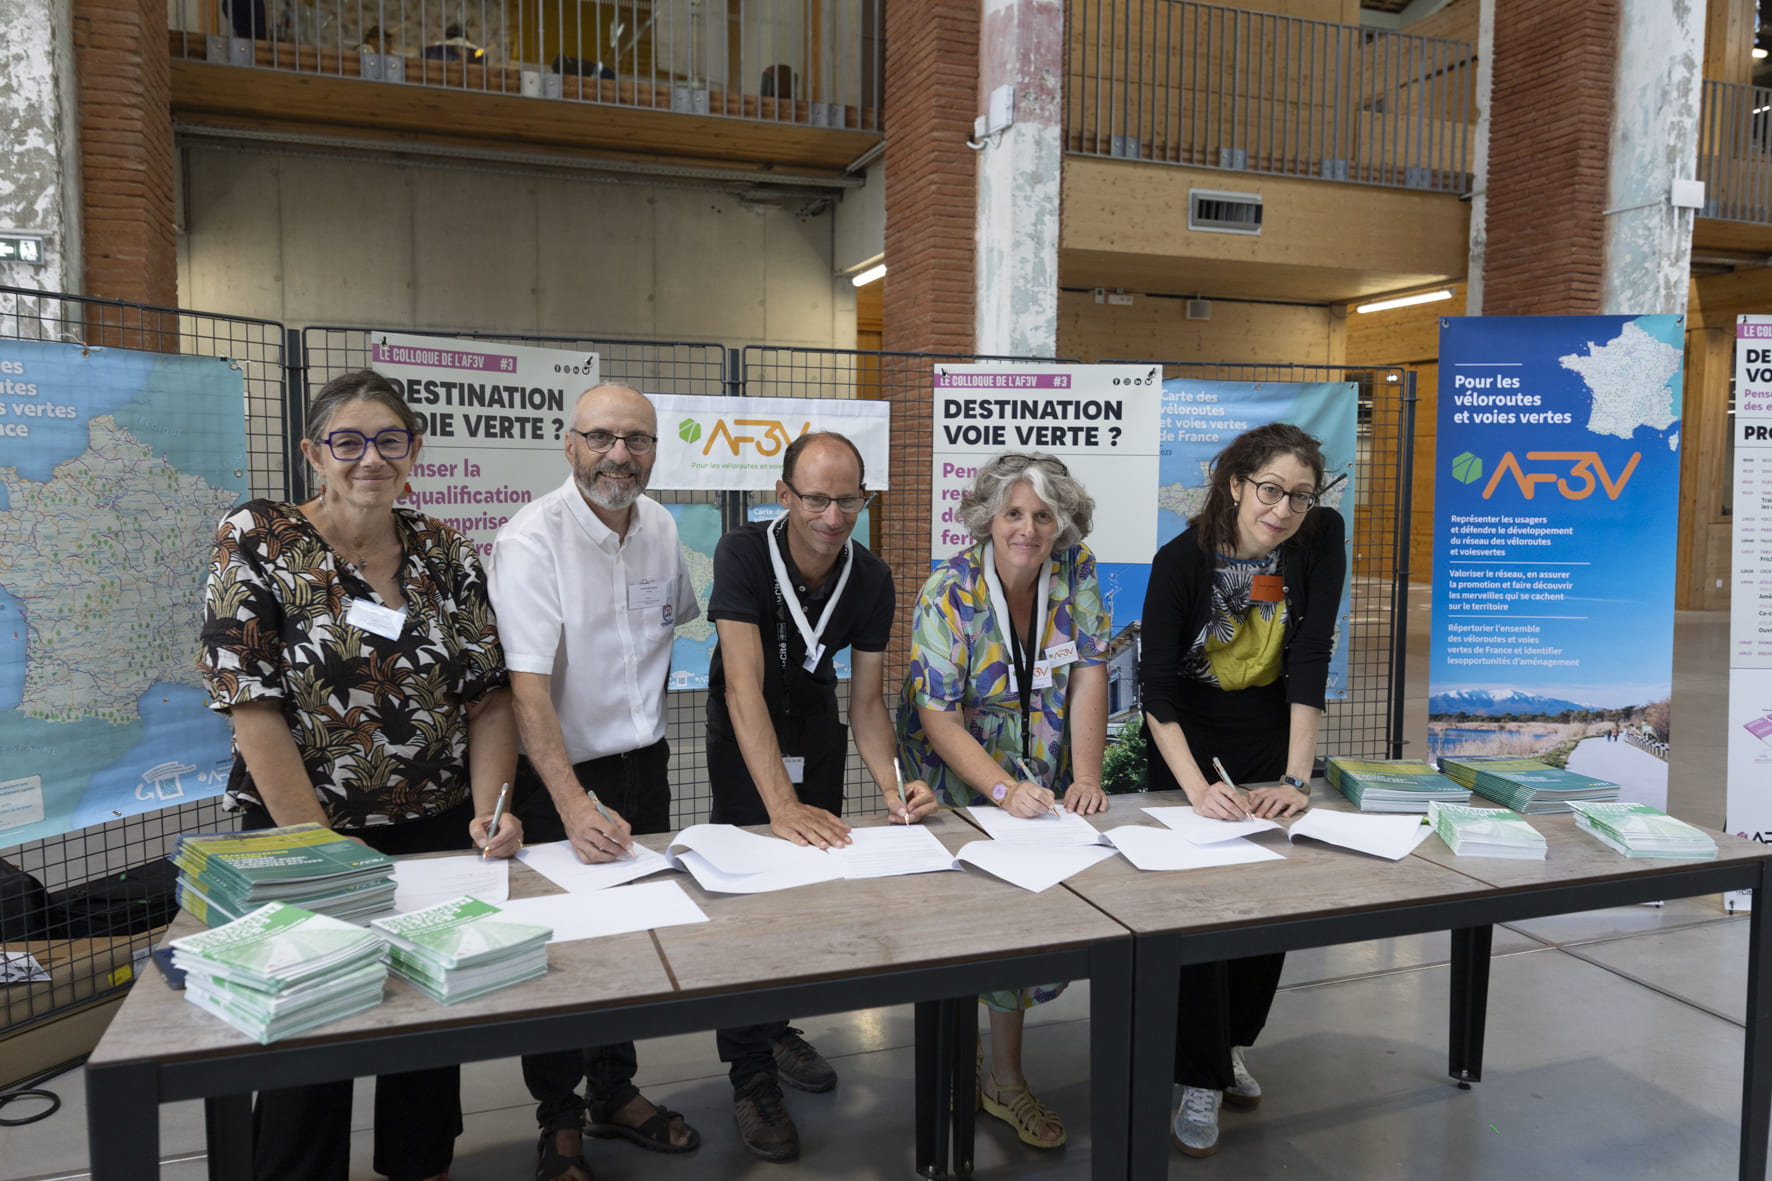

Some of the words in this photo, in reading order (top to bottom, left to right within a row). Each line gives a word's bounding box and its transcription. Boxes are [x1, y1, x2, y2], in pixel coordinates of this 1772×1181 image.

[1744, 325, 1755, 337] LE
[393, 348, 440, 365] COLLOQUE
[441, 353, 453, 366] DE
[455, 353, 485, 368] L'AF3V
[500, 358, 513, 370] #3
[952, 375, 994, 387] COLLOQUE
[996, 376, 1007, 387] DE
[1008, 376, 1038, 387] L'AF3V
[1053, 376, 1068, 388] #3
[1454, 375, 1493, 388] Pour
[1497, 374, 1520, 388] les
[1161, 389, 1194, 402] Carte
[1197, 391, 1219, 403] des
[1454, 391, 1542, 406] véloroutes
[11, 401, 78, 418] vertes
[943, 399, 1123, 421] DESTINATION
[1160, 402, 1225, 416] véloroutes
[1744, 401, 1763, 411] des
[1160, 417, 1172, 428] et
[1175, 416, 1207, 429] voies
[1209, 418, 1248, 430] vertes
[1454, 411, 1470, 424] et
[1473, 409, 1516, 424] voies
[1519, 411, 1572, 424] vertes
[463, 414, 545, 440] VERTE
[552, 418, 564, 440] ?
[943, 425, 1006, 446] VOIE
[1015, 426, 1100, 447] VERTE
[1109, 426, 1122, 447] ?
[1160, 429, 1175, 442] de
[1178, 429, 1219, 442] France
[408, 463, 458, 478] nser
[464, 458, 481, 478] la
[1482, 451, 1642, 500] AF3V
[396, 485, 532, 510] equalification
[753, 508, 774, 516] Carte
[1451, 514, 1499, 524] Représenter
[1501, 515, 1513, 524] les
[1515, 516, 1547, 525] usagers
[1450, 526, 1459, 534] et
[1460, 525, 1496, 534] défendre
[1498, 526, 1506, 534] le
[1507, 526, 1573, 536] développement
[1450, 537, 1461, 545] du
[1462, 536, 1489, 545] réseau
[1490, 537, 1505, 545] des
[1507, 537, 1551, 546] véloroutes
[1450, 548, 1459, 556] et
[1449, 569, 1485, 578] Valoriser
[1486, 570, 1494, 578] le
[1495, 569, 1526, 579] réseau,
[1539, 571, 1570, 579] assurer
[1458, 581, 1500, 590] promotion
[1502, 581, 1511, 589] et
[1512, 580, 1532, 589] faire
[1533, 581, 1573, 590] découvrir
[1449, 591, 1461, 599] les
[1462, 591, 1504, 600] merveilles
[1505, 592, 1519, 601] qui
[1531, 592, 1564, 601] cachent
[1463, 602, 1471, 610] le
[1472, 602, 1509, 611] territoire
[1448, 623, 1494, 633] Répertorier
[1495, 624, 1540, 633] l'ensemble
[1448, 635, 1462, 643] des
[1463, 634, 1506, 643] véloroutes
[1517, 635, 1540, 644] voies
[1447, 646, 1473, 654] vertes
[1474, 646, 1484, 654] de
[1485, 646, 1512, 654] France
[1524, 646, 1562, 655] identifier
[1512, 657, 1579, 667] d'aménagement
